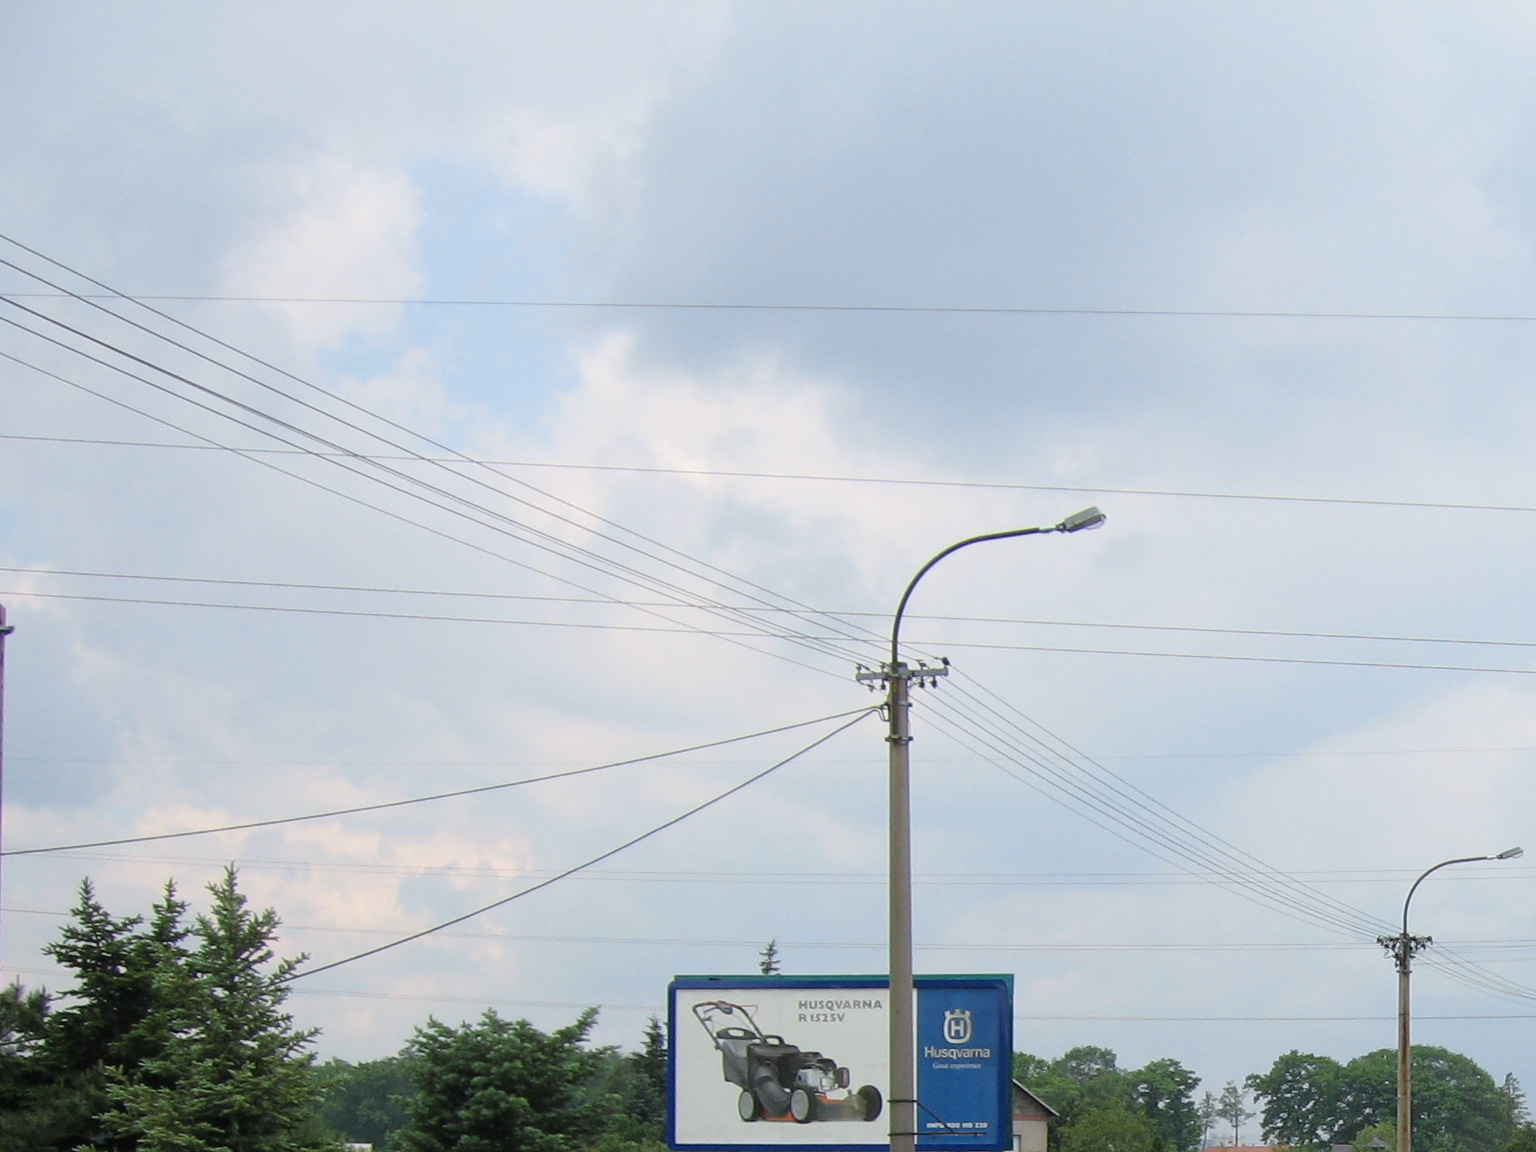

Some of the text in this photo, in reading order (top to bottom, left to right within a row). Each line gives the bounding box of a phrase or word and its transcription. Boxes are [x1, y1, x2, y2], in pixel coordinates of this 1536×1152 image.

[798, 999, 883, 1011] HUSQVARNA
[798, 1013, 807, 1023] R
[924, 1046, 991, 1060] Husqvarna
